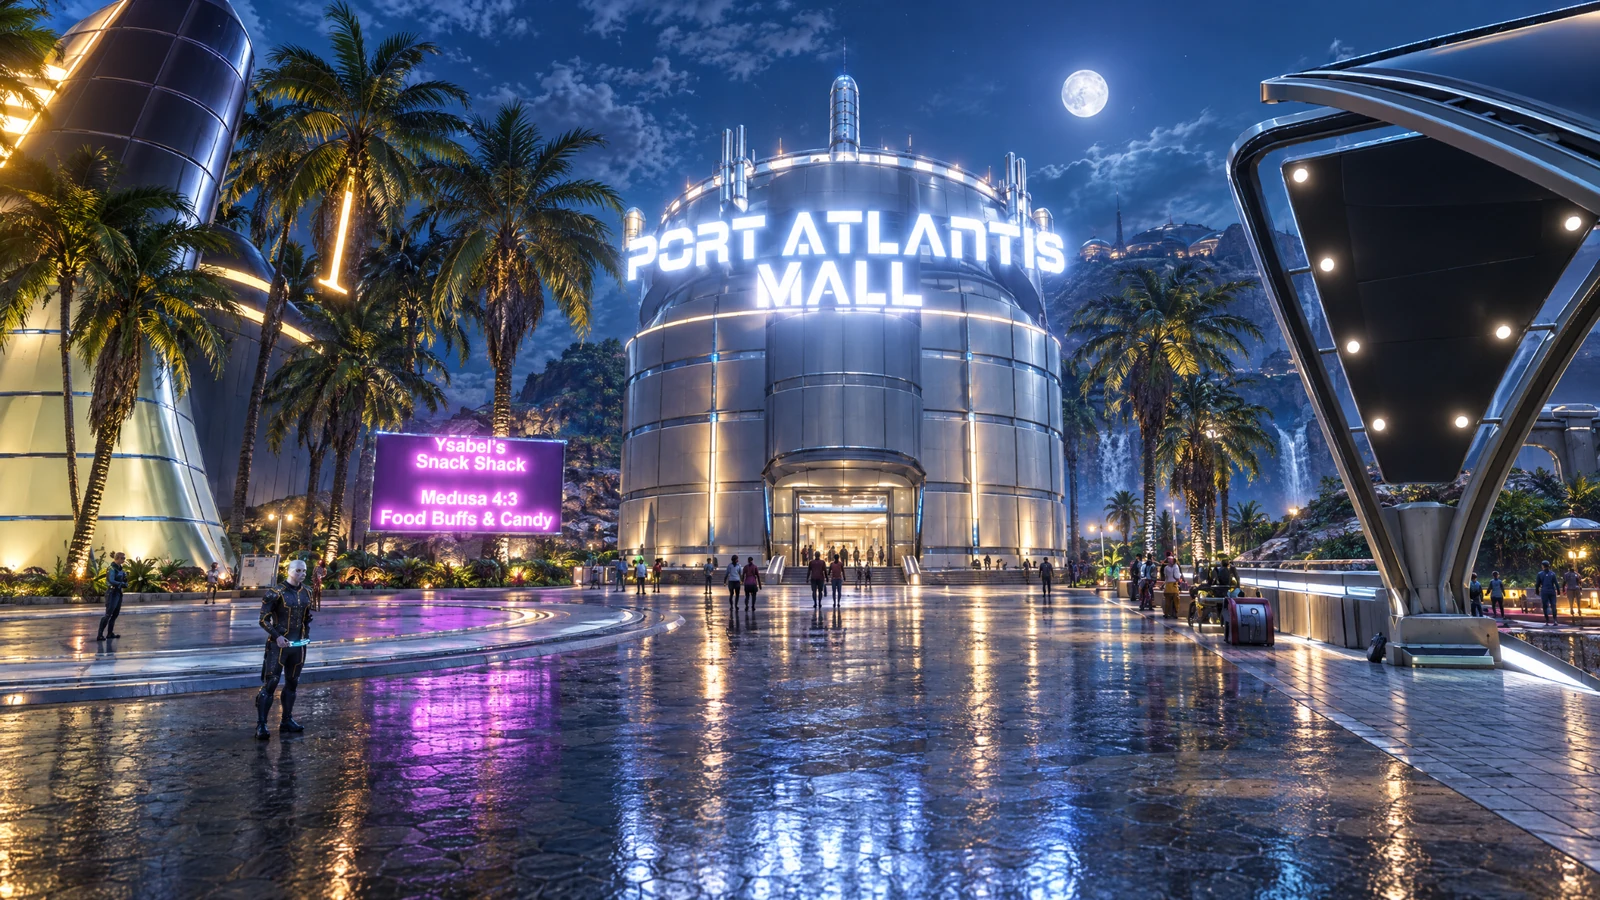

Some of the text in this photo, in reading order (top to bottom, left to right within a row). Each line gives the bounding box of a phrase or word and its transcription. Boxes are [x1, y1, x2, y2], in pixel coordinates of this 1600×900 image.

[627, 210, 1066, 281] PORT ATLANTIS
[757, 260, 923, 309] MALL
[435, 437, 506, 454] Ysabel's
[416, 454, 526, 472] Snack Shack
[421, 490, 518, 506] Medusa 4:3
[380, 510, 552, 530] Food Buffs & Candy
